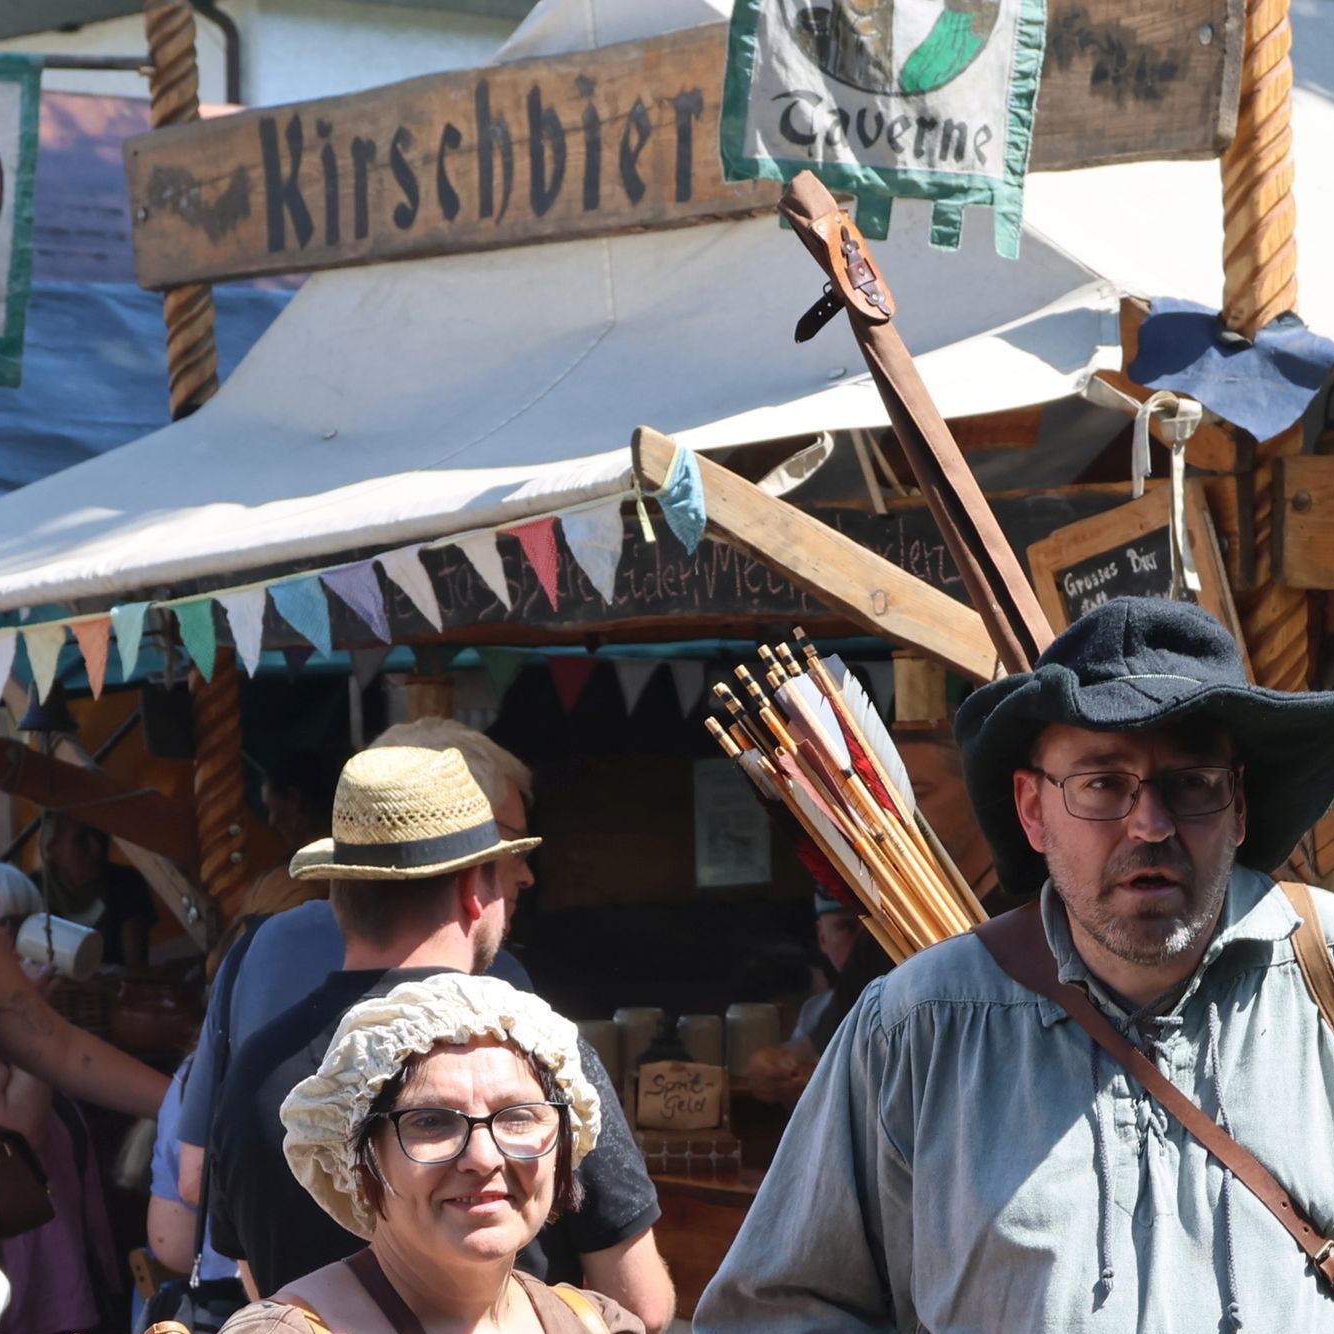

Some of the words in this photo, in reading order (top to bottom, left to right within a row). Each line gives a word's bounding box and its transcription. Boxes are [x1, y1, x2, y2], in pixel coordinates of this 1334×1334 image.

[771, 90, 993, 166] Taverne
[258, 73, 703, 253] Kirschbier
[1064, 562, 1118, 598] Grosses
[1126, 547, 1158, 574] Bier
[660, 1095, 707, 1120] Geld
